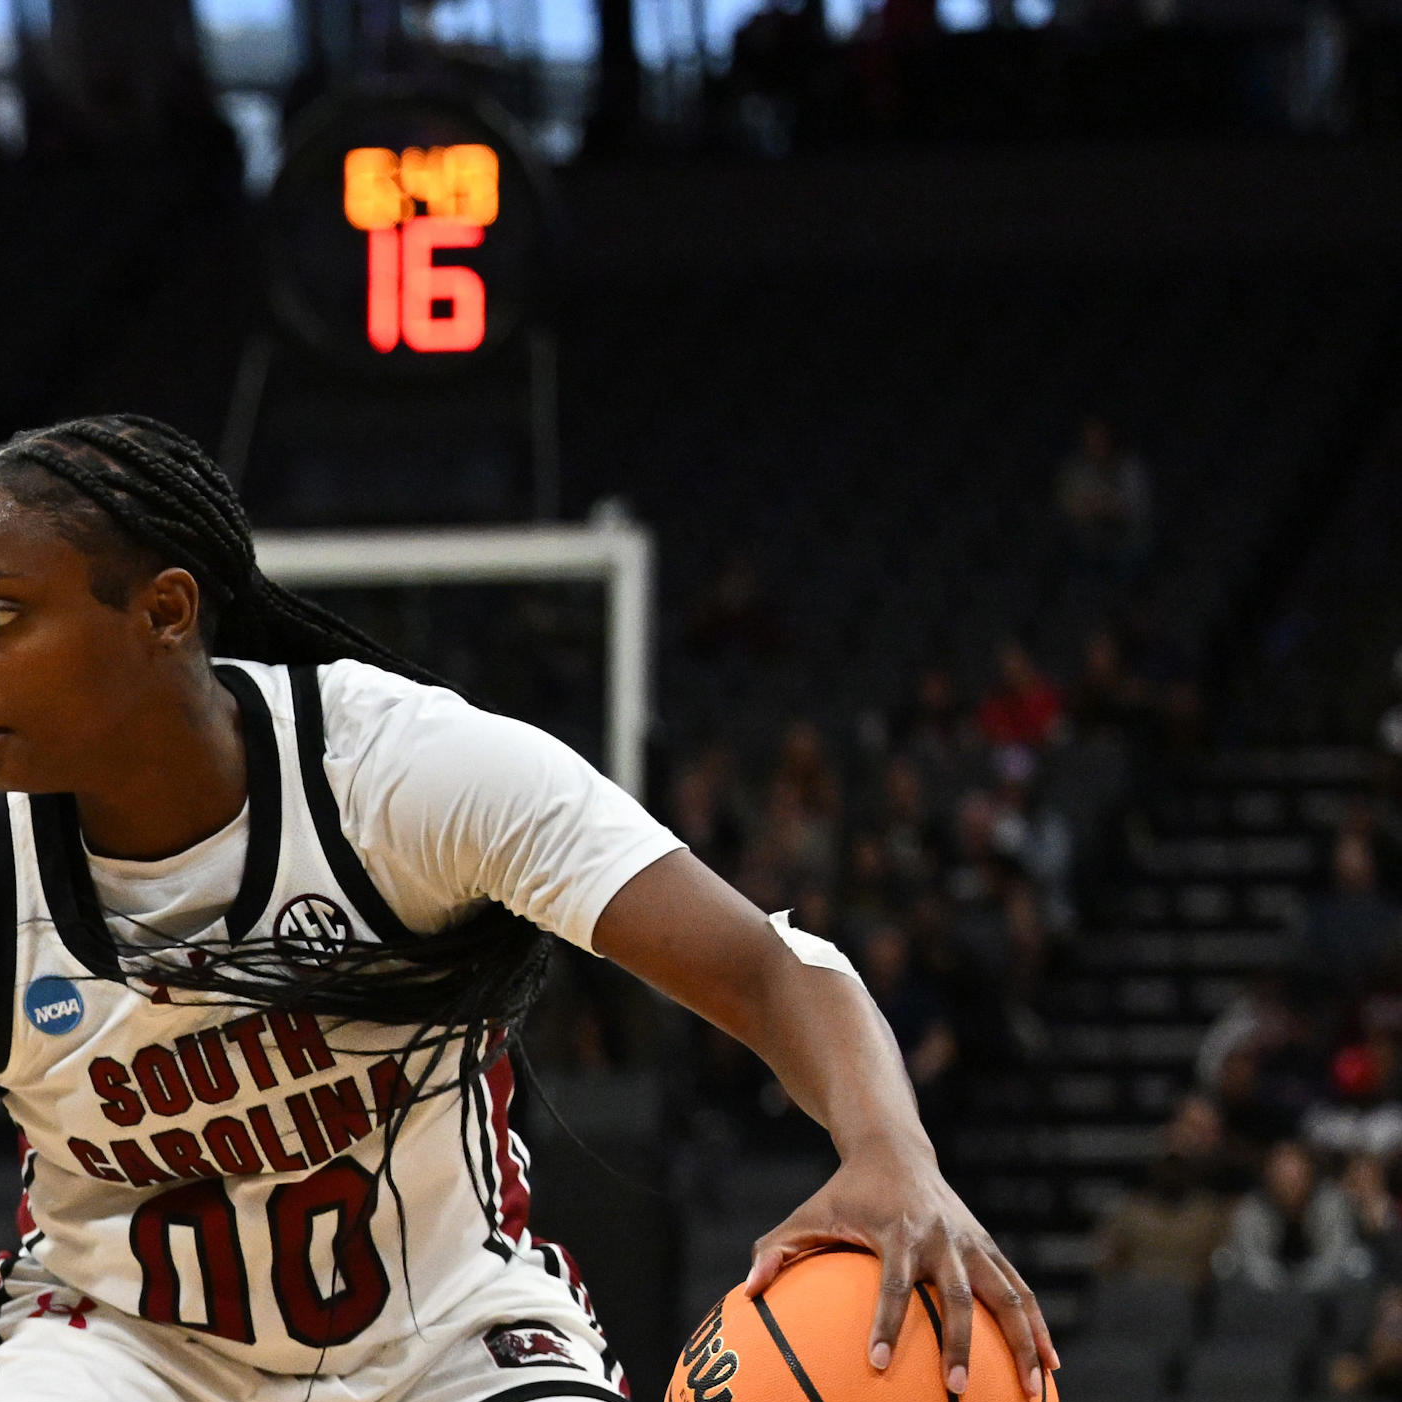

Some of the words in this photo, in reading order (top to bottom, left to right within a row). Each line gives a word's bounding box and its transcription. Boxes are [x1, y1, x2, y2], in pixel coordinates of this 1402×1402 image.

[367, 216, 486, 353] 16
[34, 998, 80, 1024] NCAA
[88, 1004, 336, 1127] SOUTH
[67, 1055, 414, 1188] CAROLINA
[130, 1154, 390, 1348] 00
